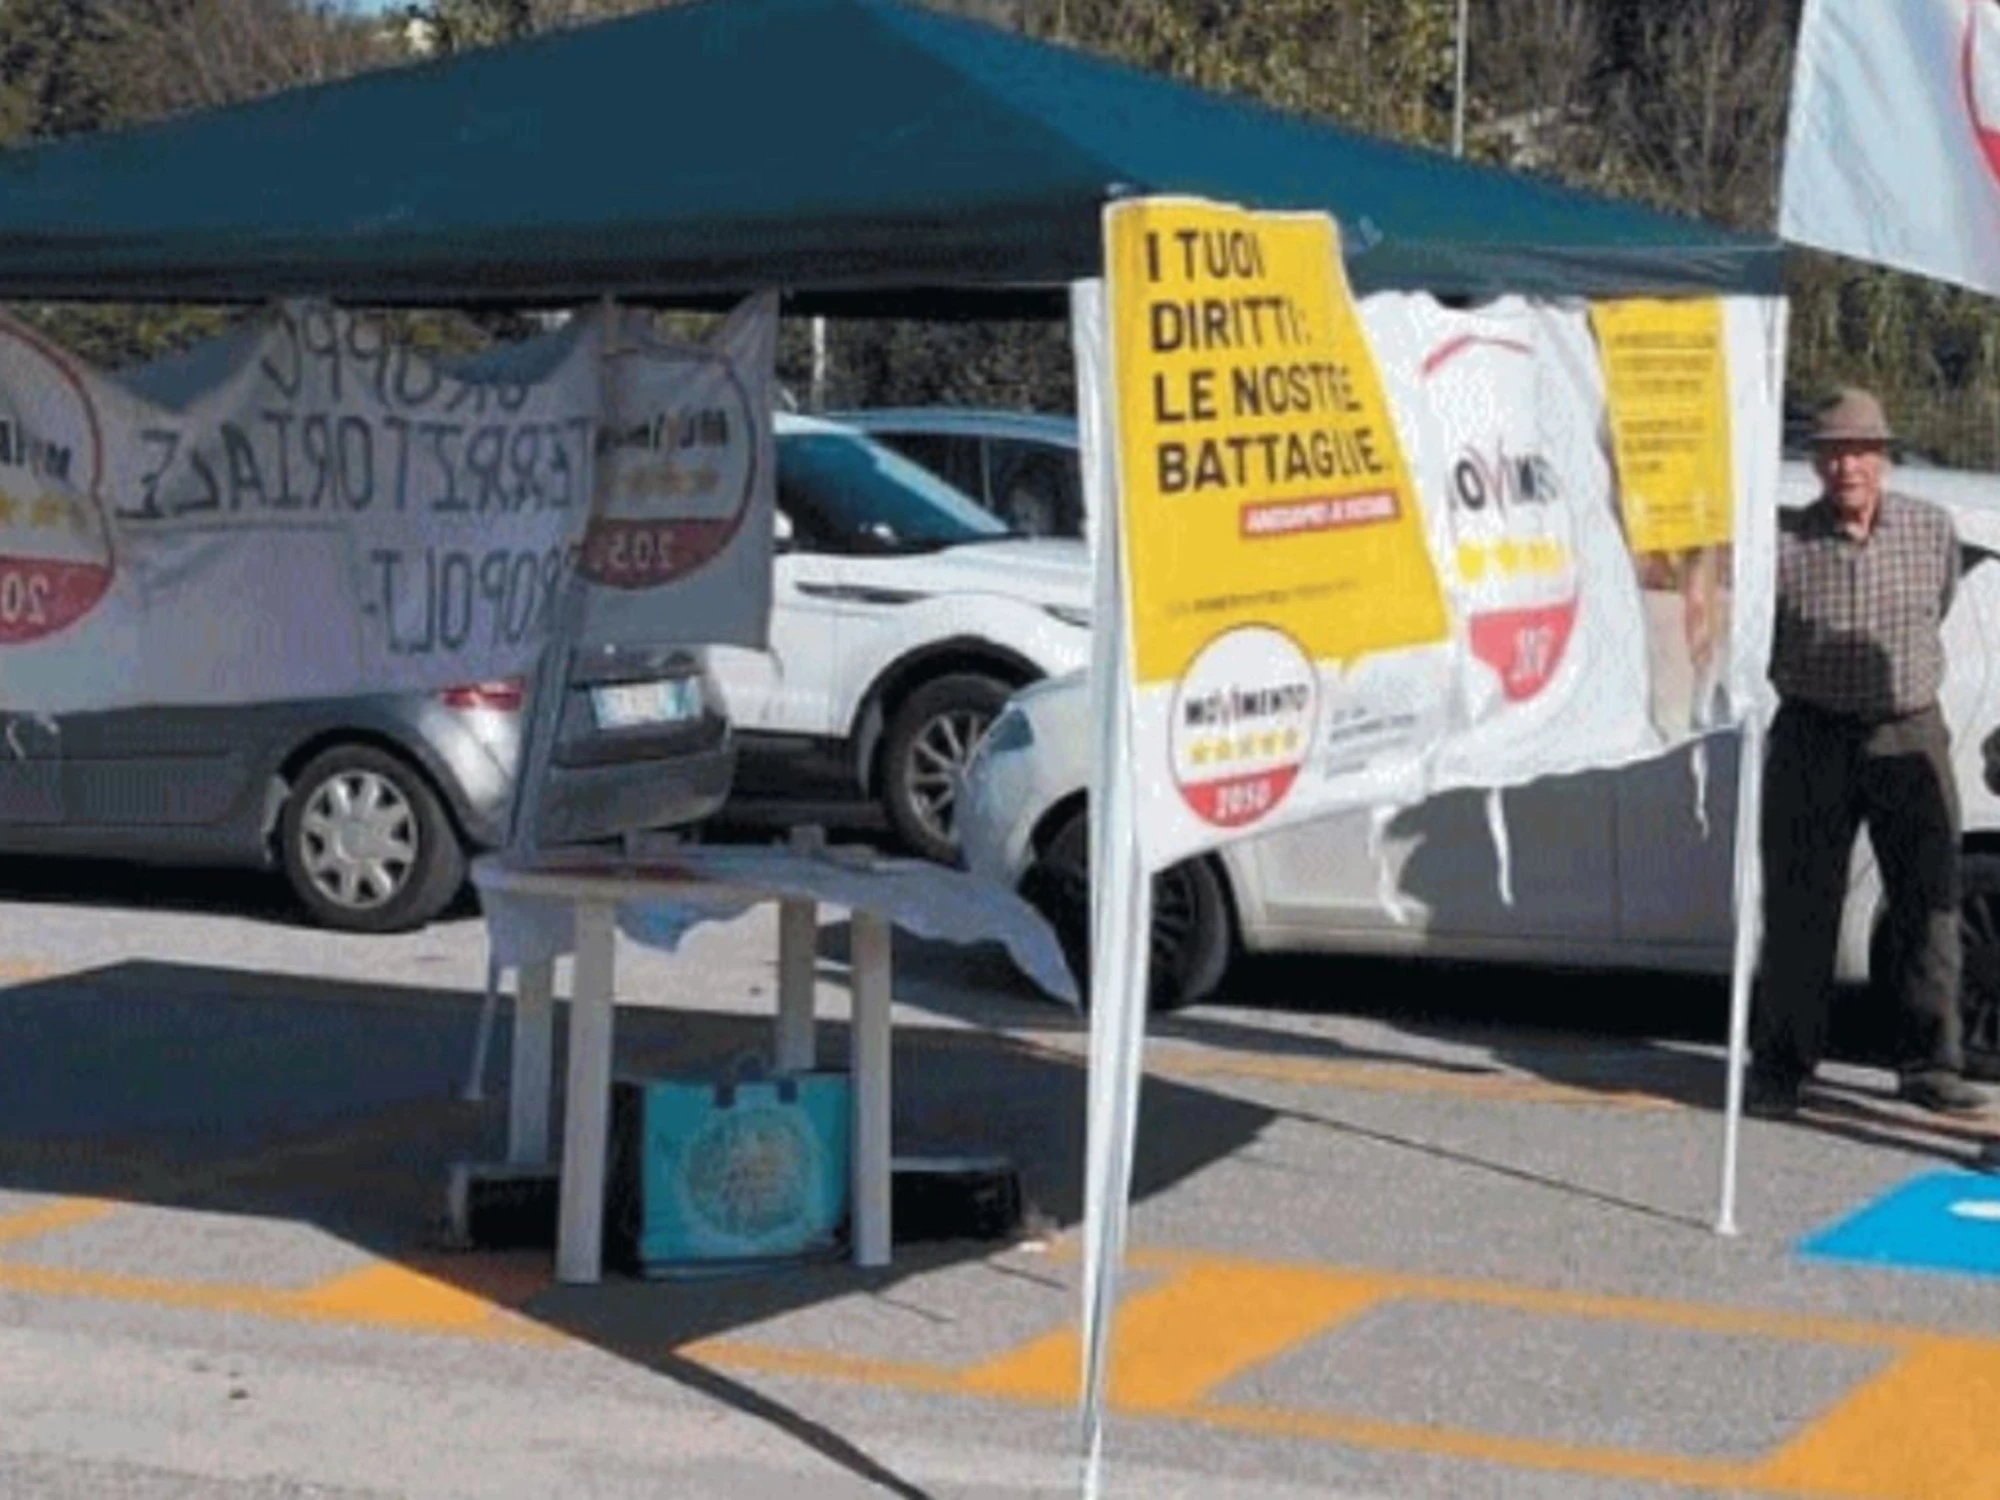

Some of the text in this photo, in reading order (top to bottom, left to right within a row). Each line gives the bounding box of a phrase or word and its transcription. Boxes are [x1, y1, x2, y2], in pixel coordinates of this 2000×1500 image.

[1146, 227, 1266, 282] I TUOI
[1153, 362, 1363, 424] LE NOSTRE
